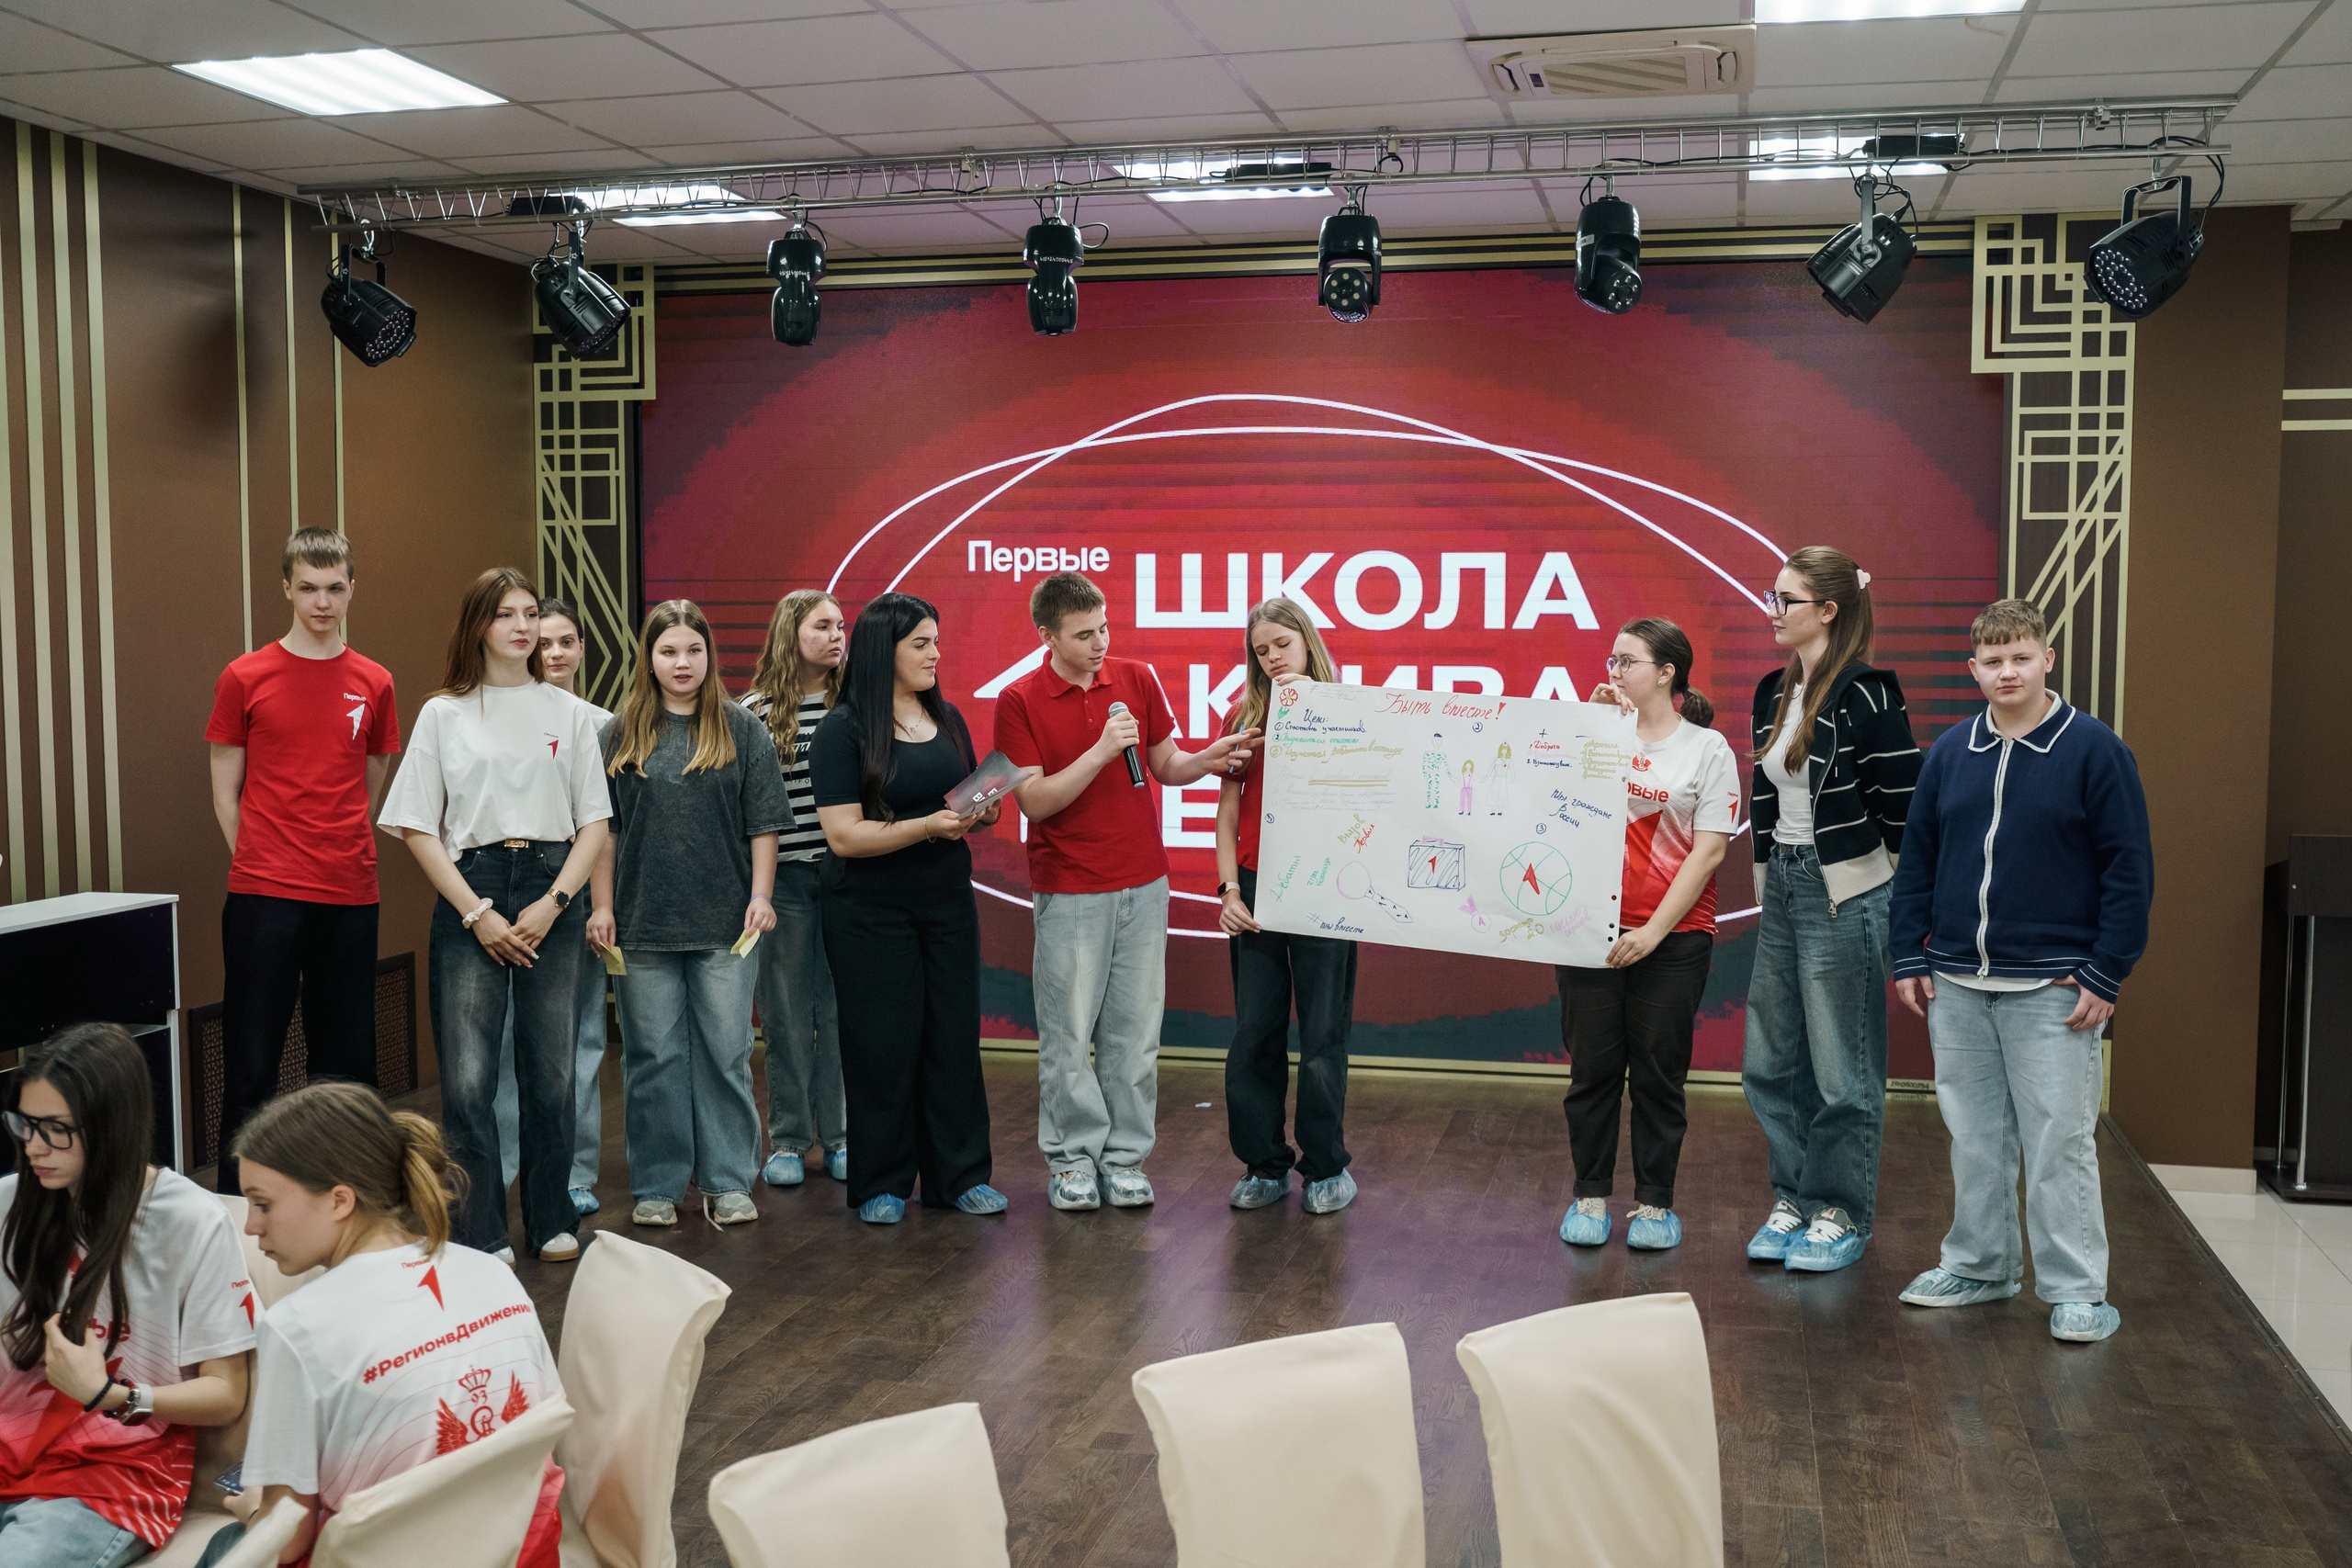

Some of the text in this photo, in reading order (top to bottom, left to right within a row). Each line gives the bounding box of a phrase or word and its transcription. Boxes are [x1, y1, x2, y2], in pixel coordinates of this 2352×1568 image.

[968, 540, 1110, 581] Первые
[1136, 551, 1600, 630] ШКОЛА
[1374, 693, 1431, 716] Быть
